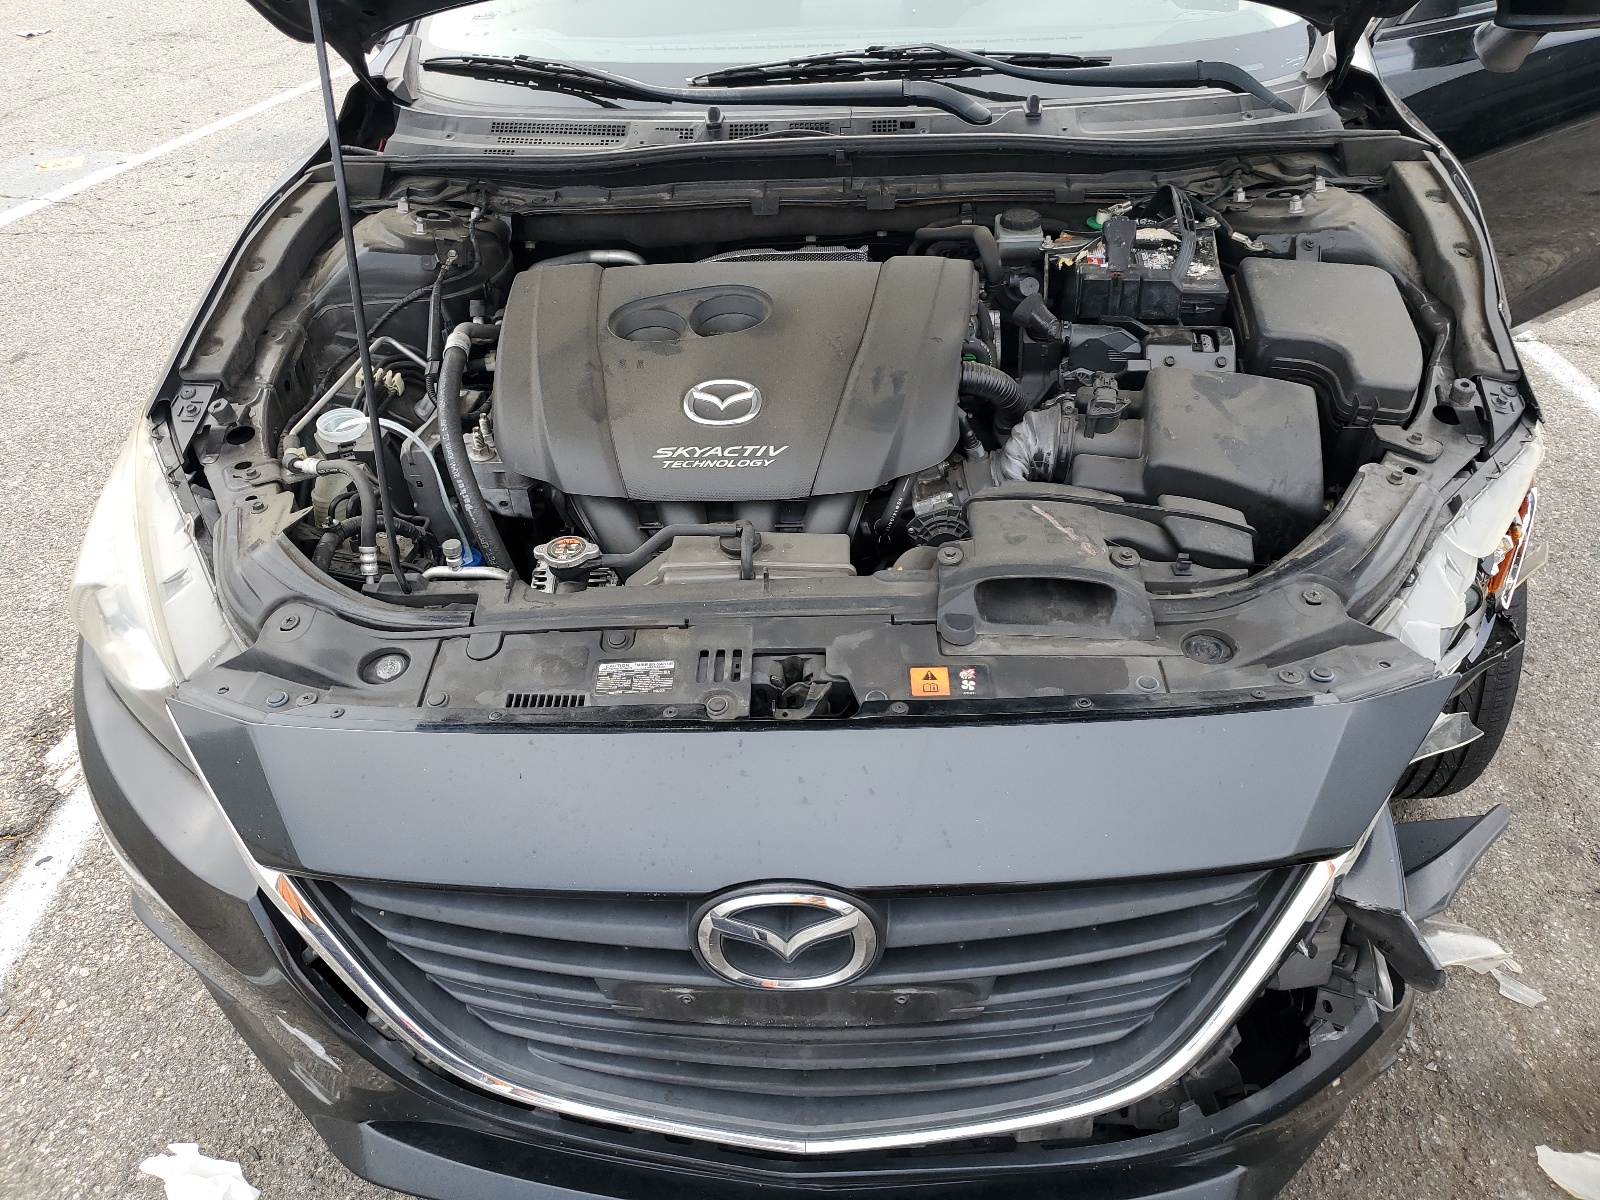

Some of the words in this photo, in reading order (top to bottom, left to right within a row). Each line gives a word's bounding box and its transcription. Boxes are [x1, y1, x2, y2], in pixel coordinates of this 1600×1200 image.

[652, 445, 789, 459] SKYACTIV
[662, 459, 777, 469] TECHNOLOGY
[456, 480, 474, 510] Parker
